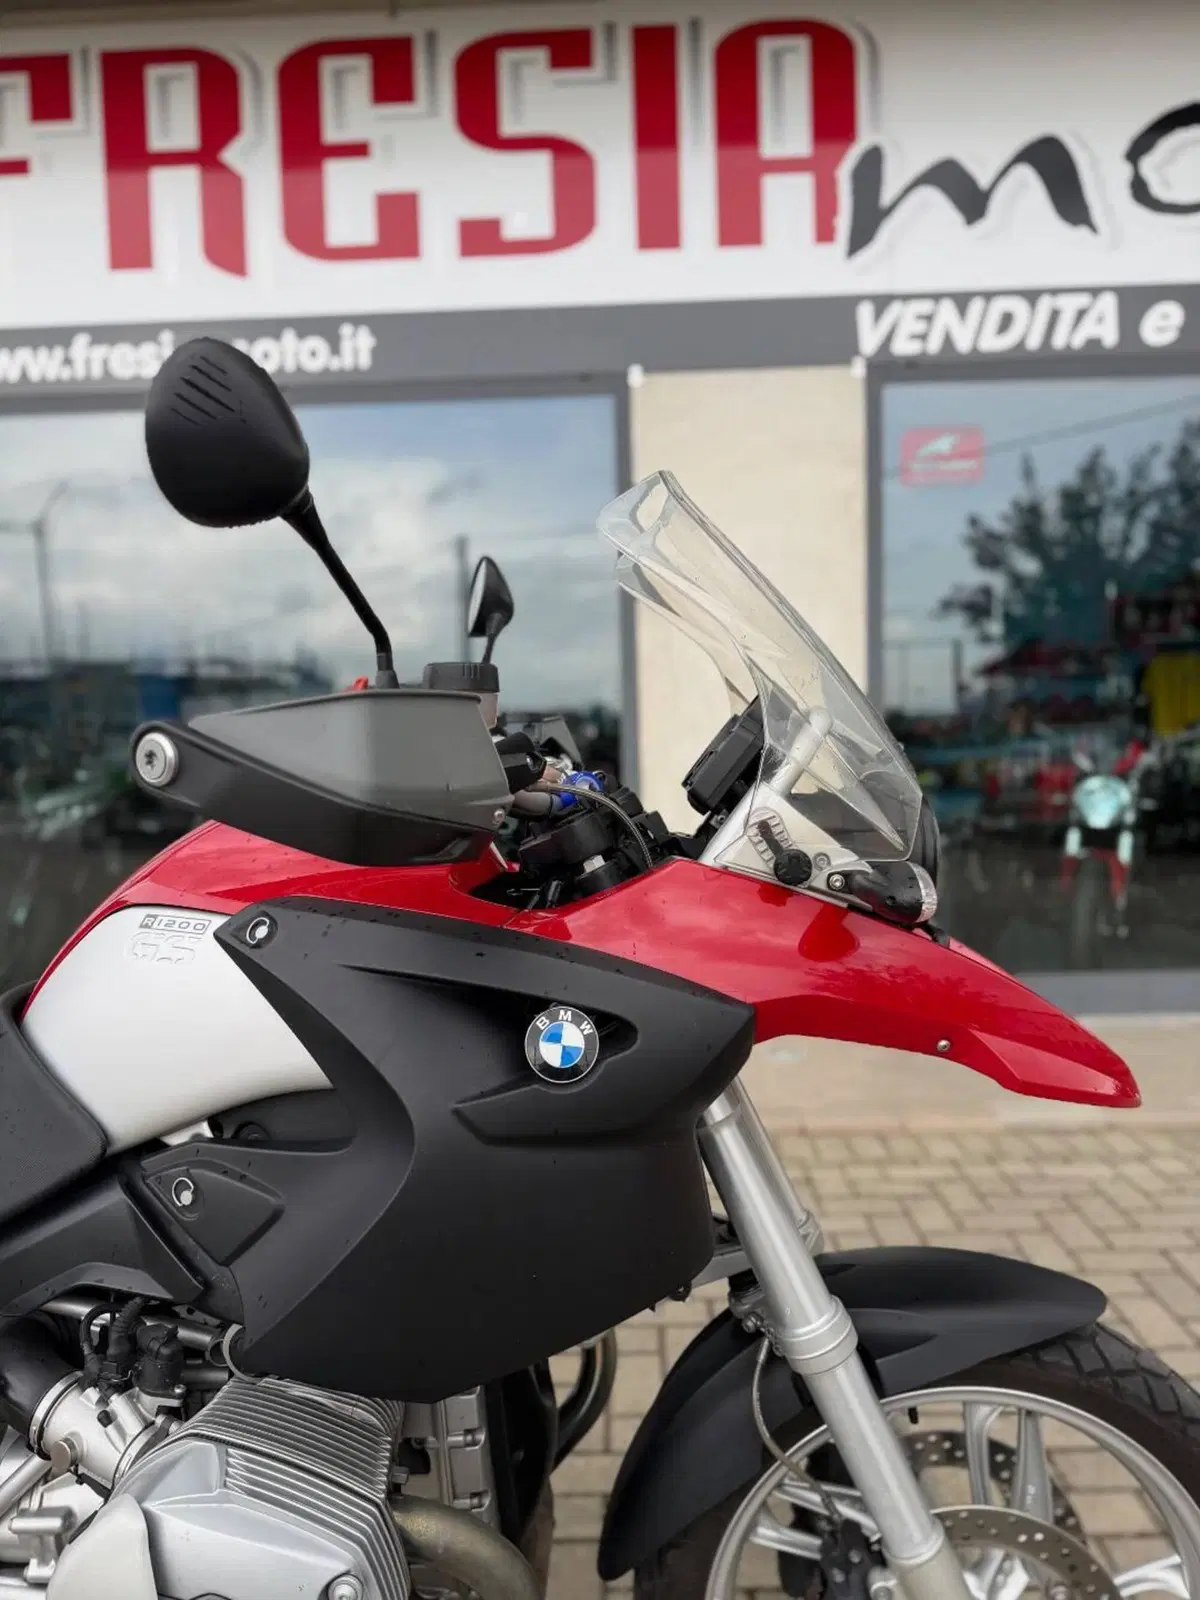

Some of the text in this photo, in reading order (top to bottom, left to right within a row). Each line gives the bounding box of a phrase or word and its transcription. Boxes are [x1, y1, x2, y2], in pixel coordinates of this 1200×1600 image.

[855, 290, 1186, 357] VENDITA e
[536, 1009, 593, 1036] BMW
